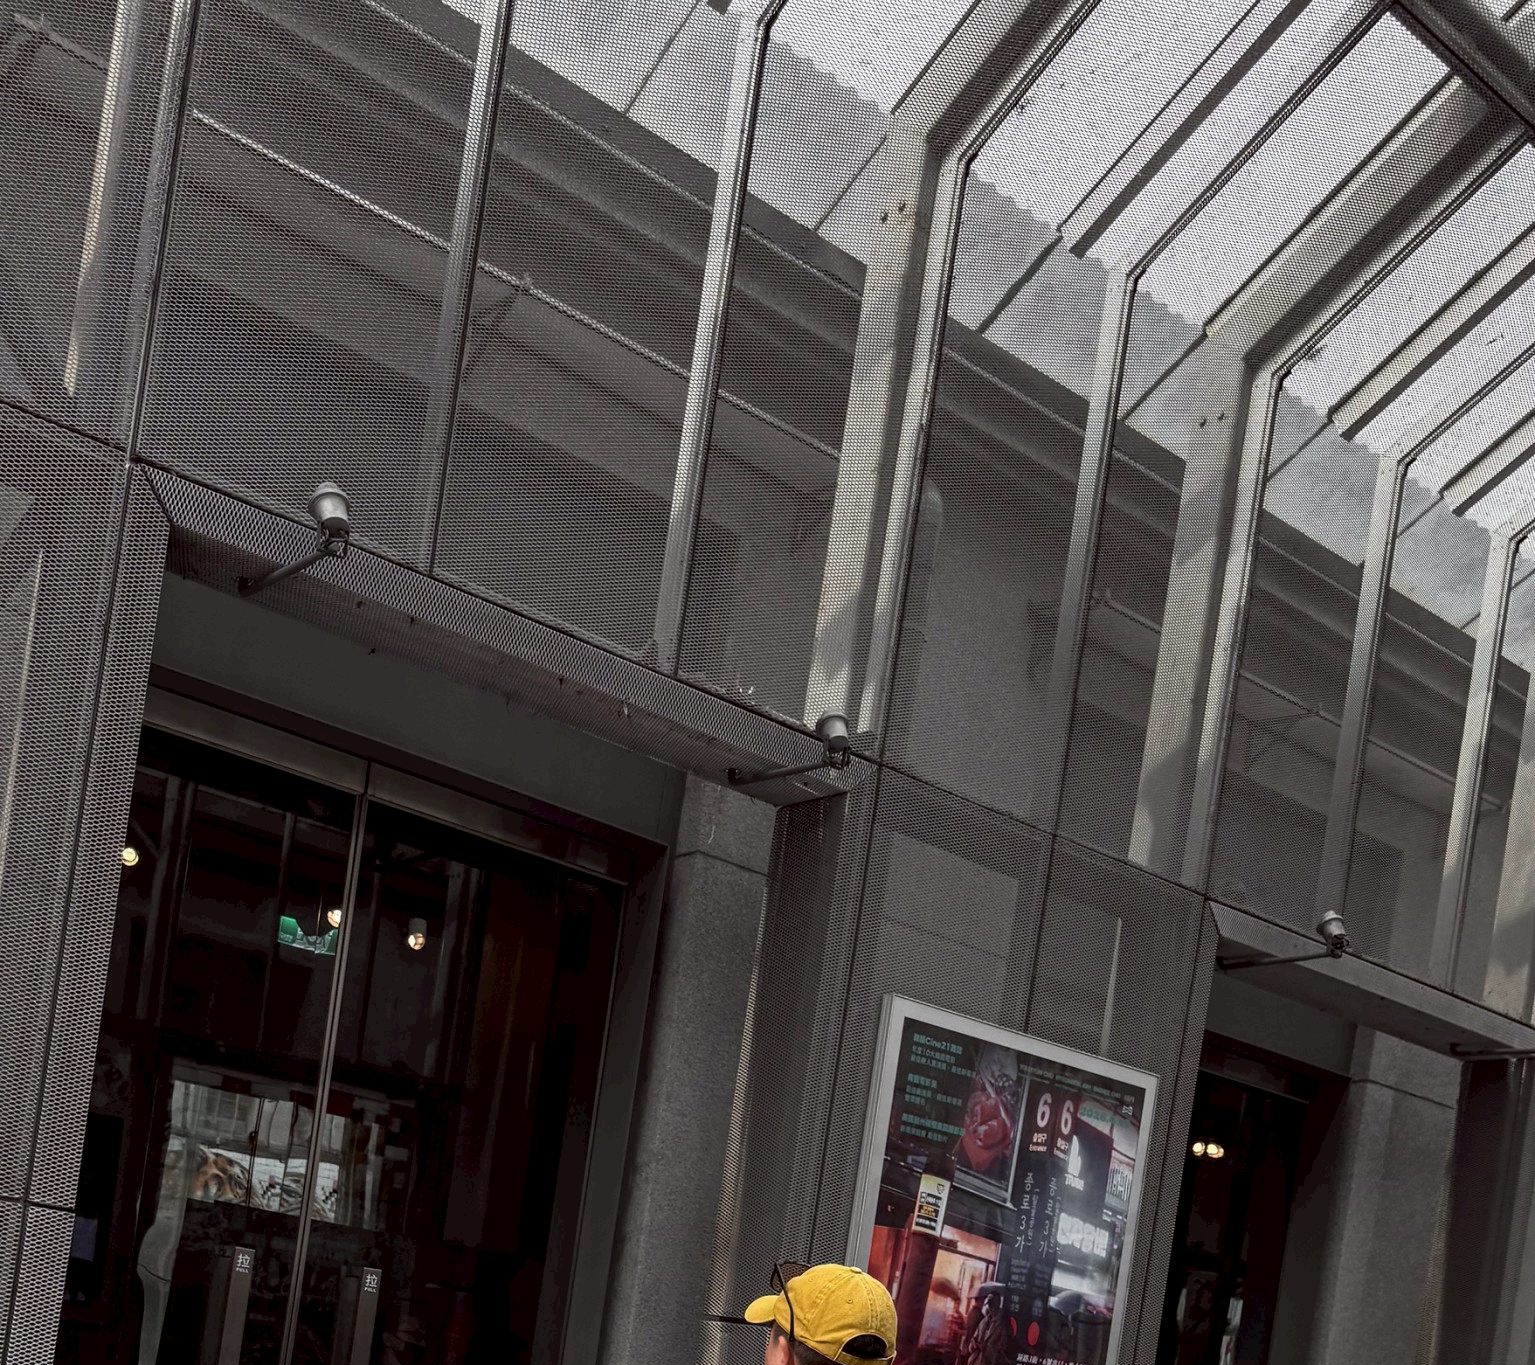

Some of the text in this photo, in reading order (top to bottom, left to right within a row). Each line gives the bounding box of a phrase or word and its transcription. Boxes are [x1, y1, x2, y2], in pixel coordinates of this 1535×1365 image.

[1037, 1093, 1052, 1128] 6
[1061, 1100, 1074, 1135] 6
[236, 1253, 251, 1268] 拉
[365, 1273, 378, 1288] 拉
